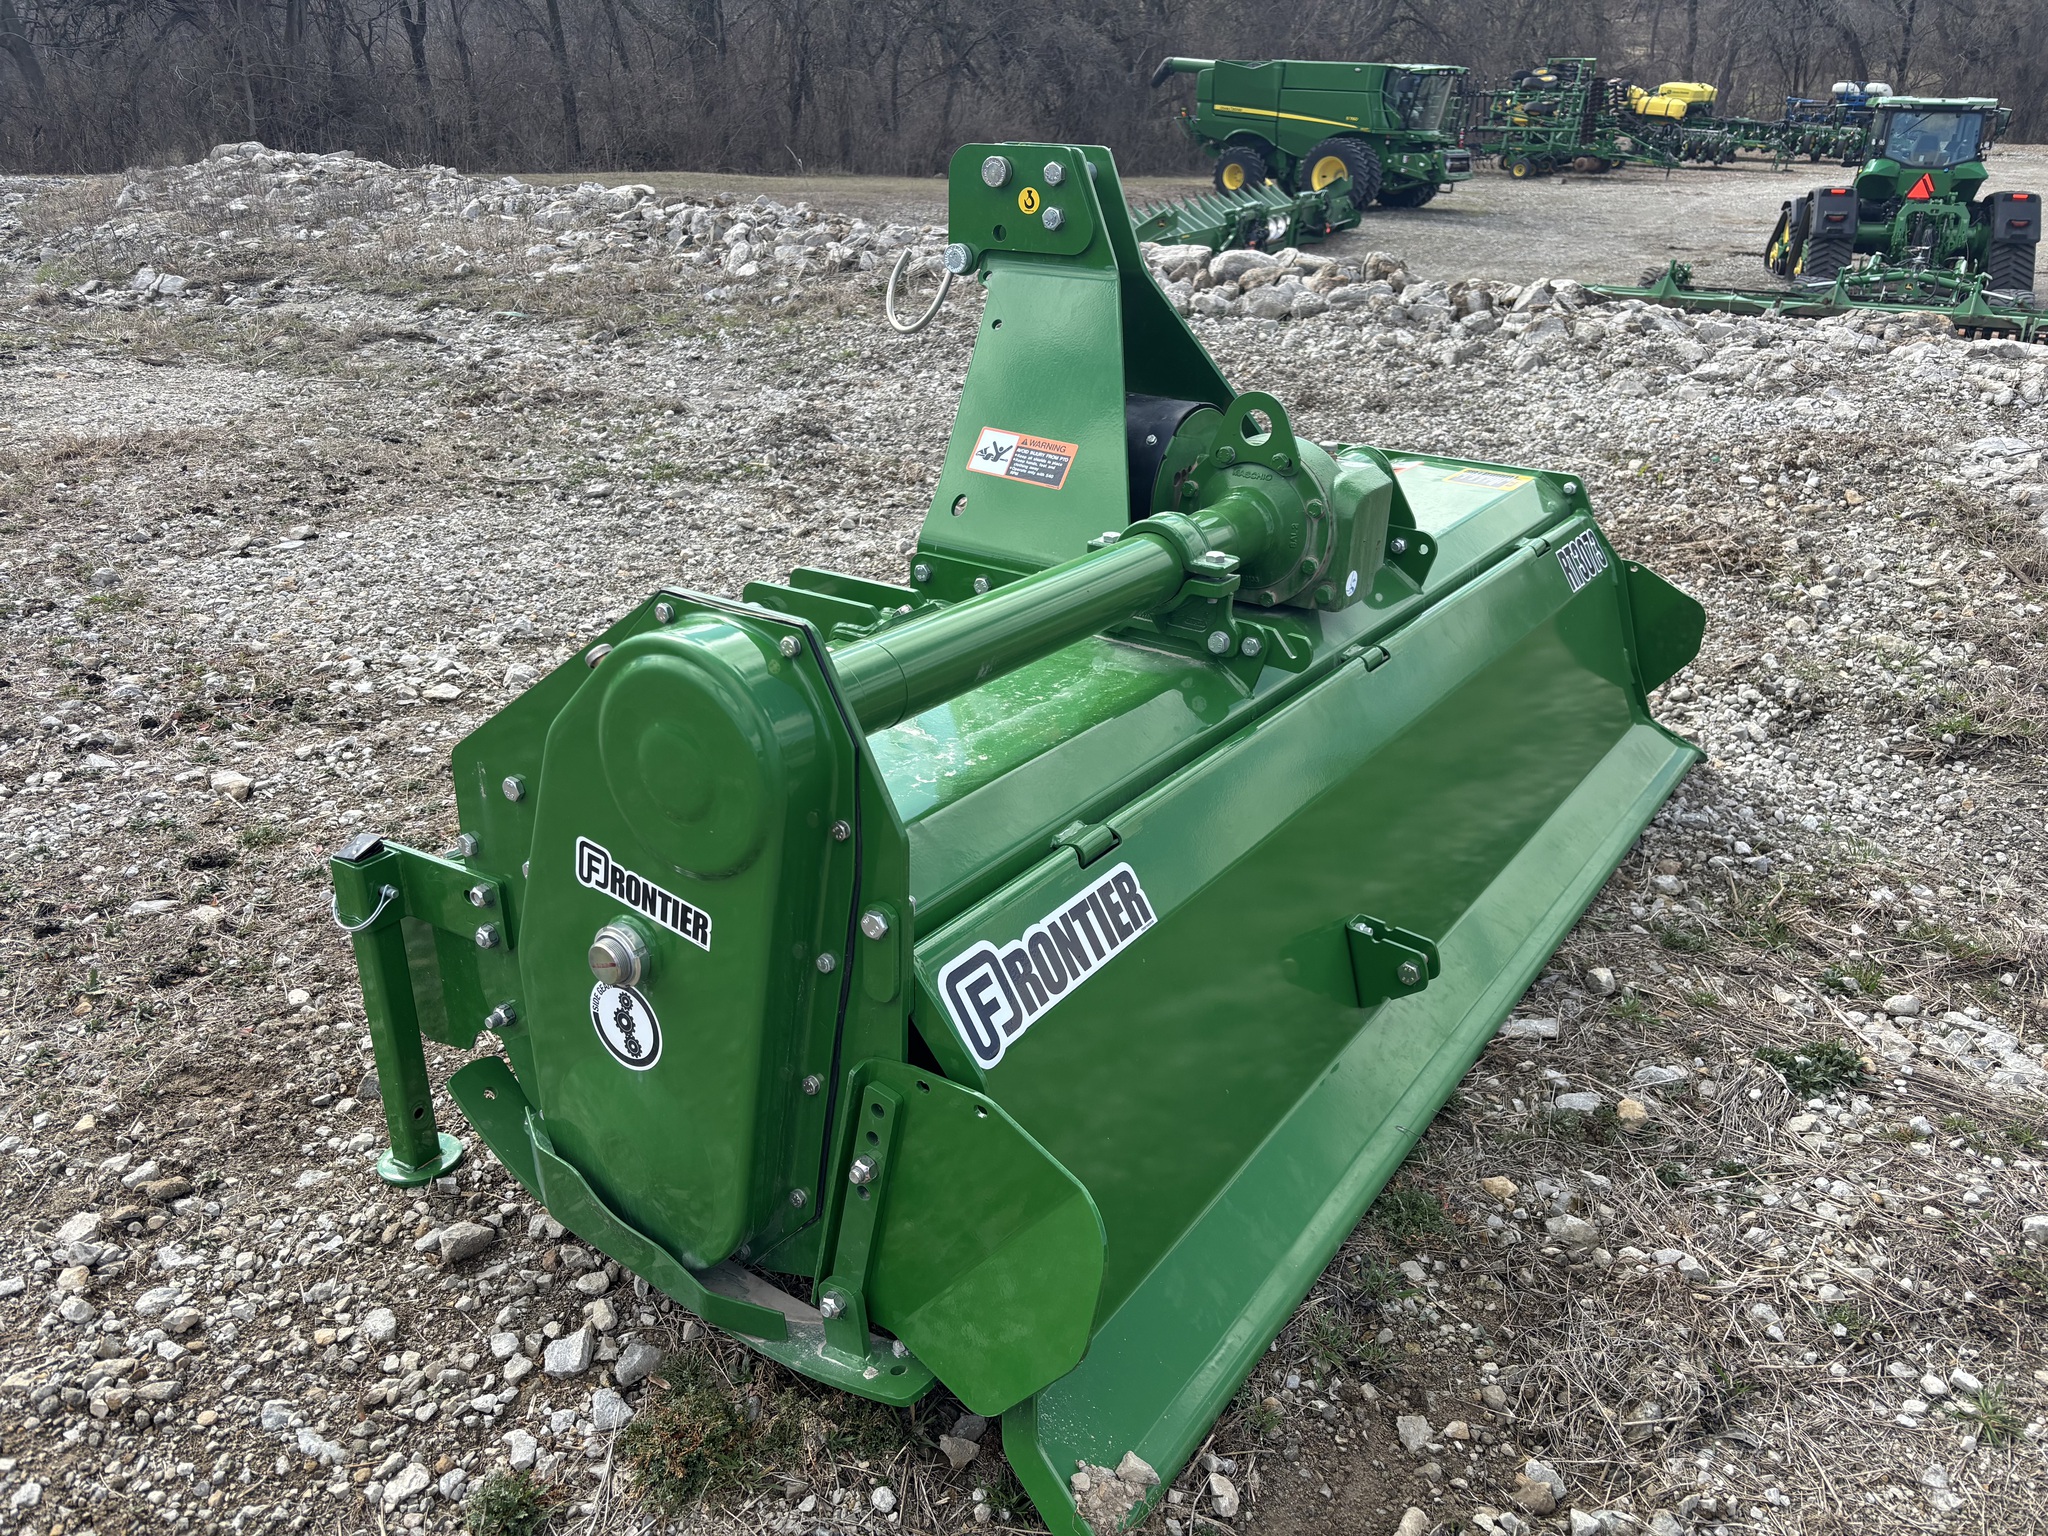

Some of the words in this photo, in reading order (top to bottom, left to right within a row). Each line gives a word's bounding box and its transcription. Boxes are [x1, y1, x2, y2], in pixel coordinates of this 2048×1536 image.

[1029, 439, 1067, 453] WARNING
[1556, 528, 1607, 592] RT3073
[579, 840, 709, 946] FRONTIER
[945, 870, 1152, 1061] FRONTIER
[592, 993, 601, 1012] SIDE
